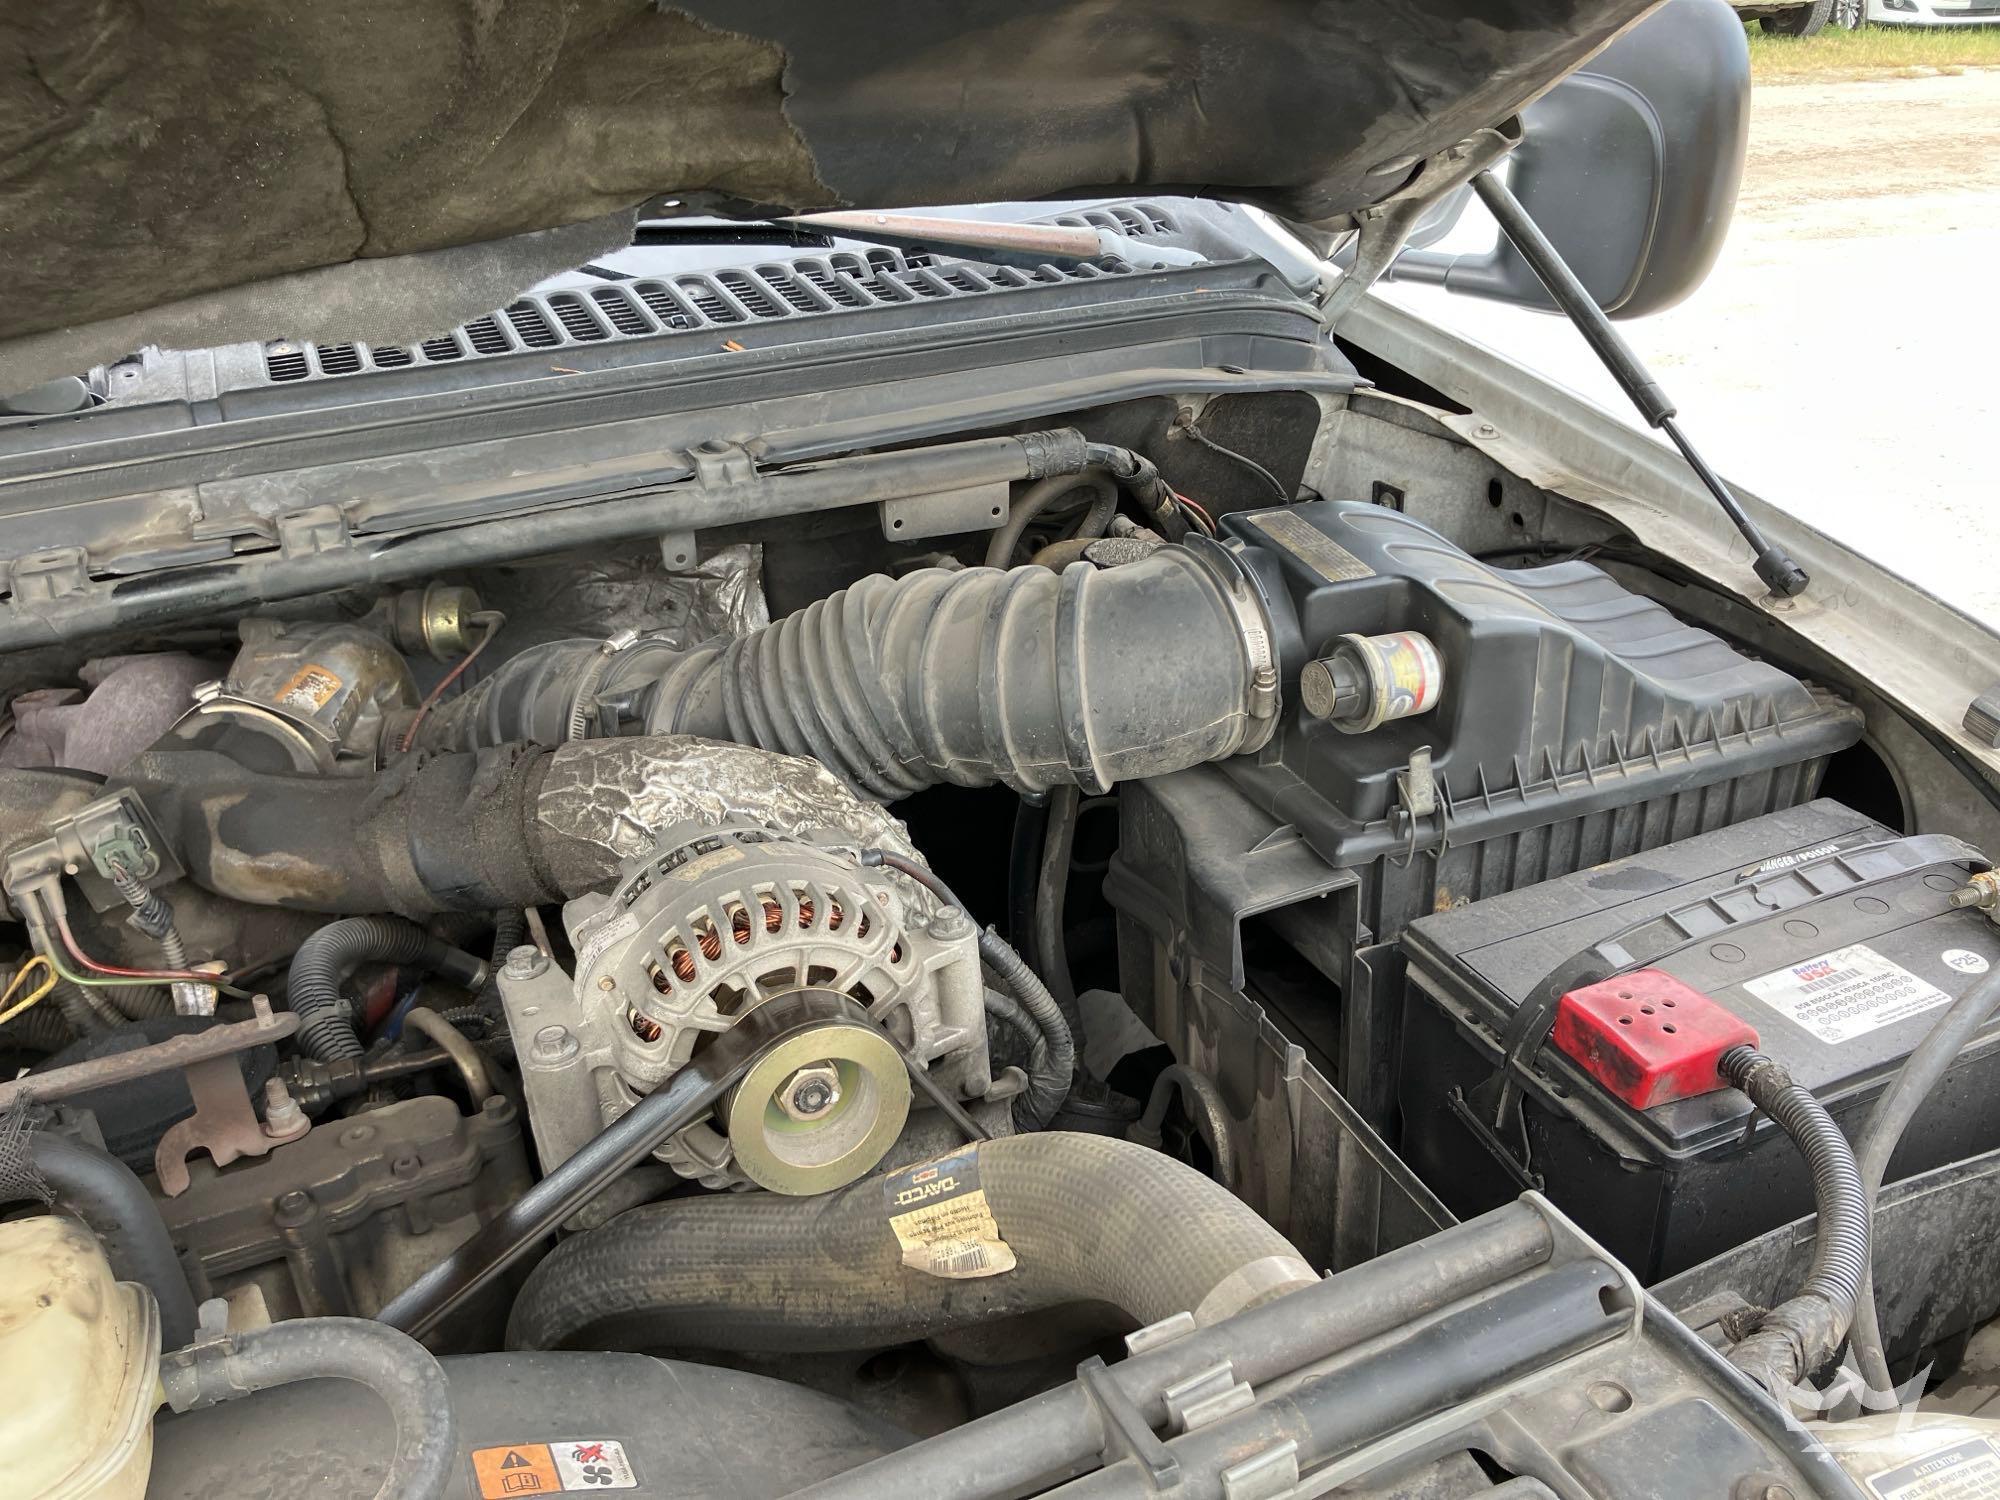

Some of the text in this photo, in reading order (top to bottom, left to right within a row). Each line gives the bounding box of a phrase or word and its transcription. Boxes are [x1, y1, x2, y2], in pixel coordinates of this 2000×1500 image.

[1951, 954, 1979, 968] F25
[1798, 967, 1838, 981] USA
[895, 1176, 960, 1205] DAYCO
